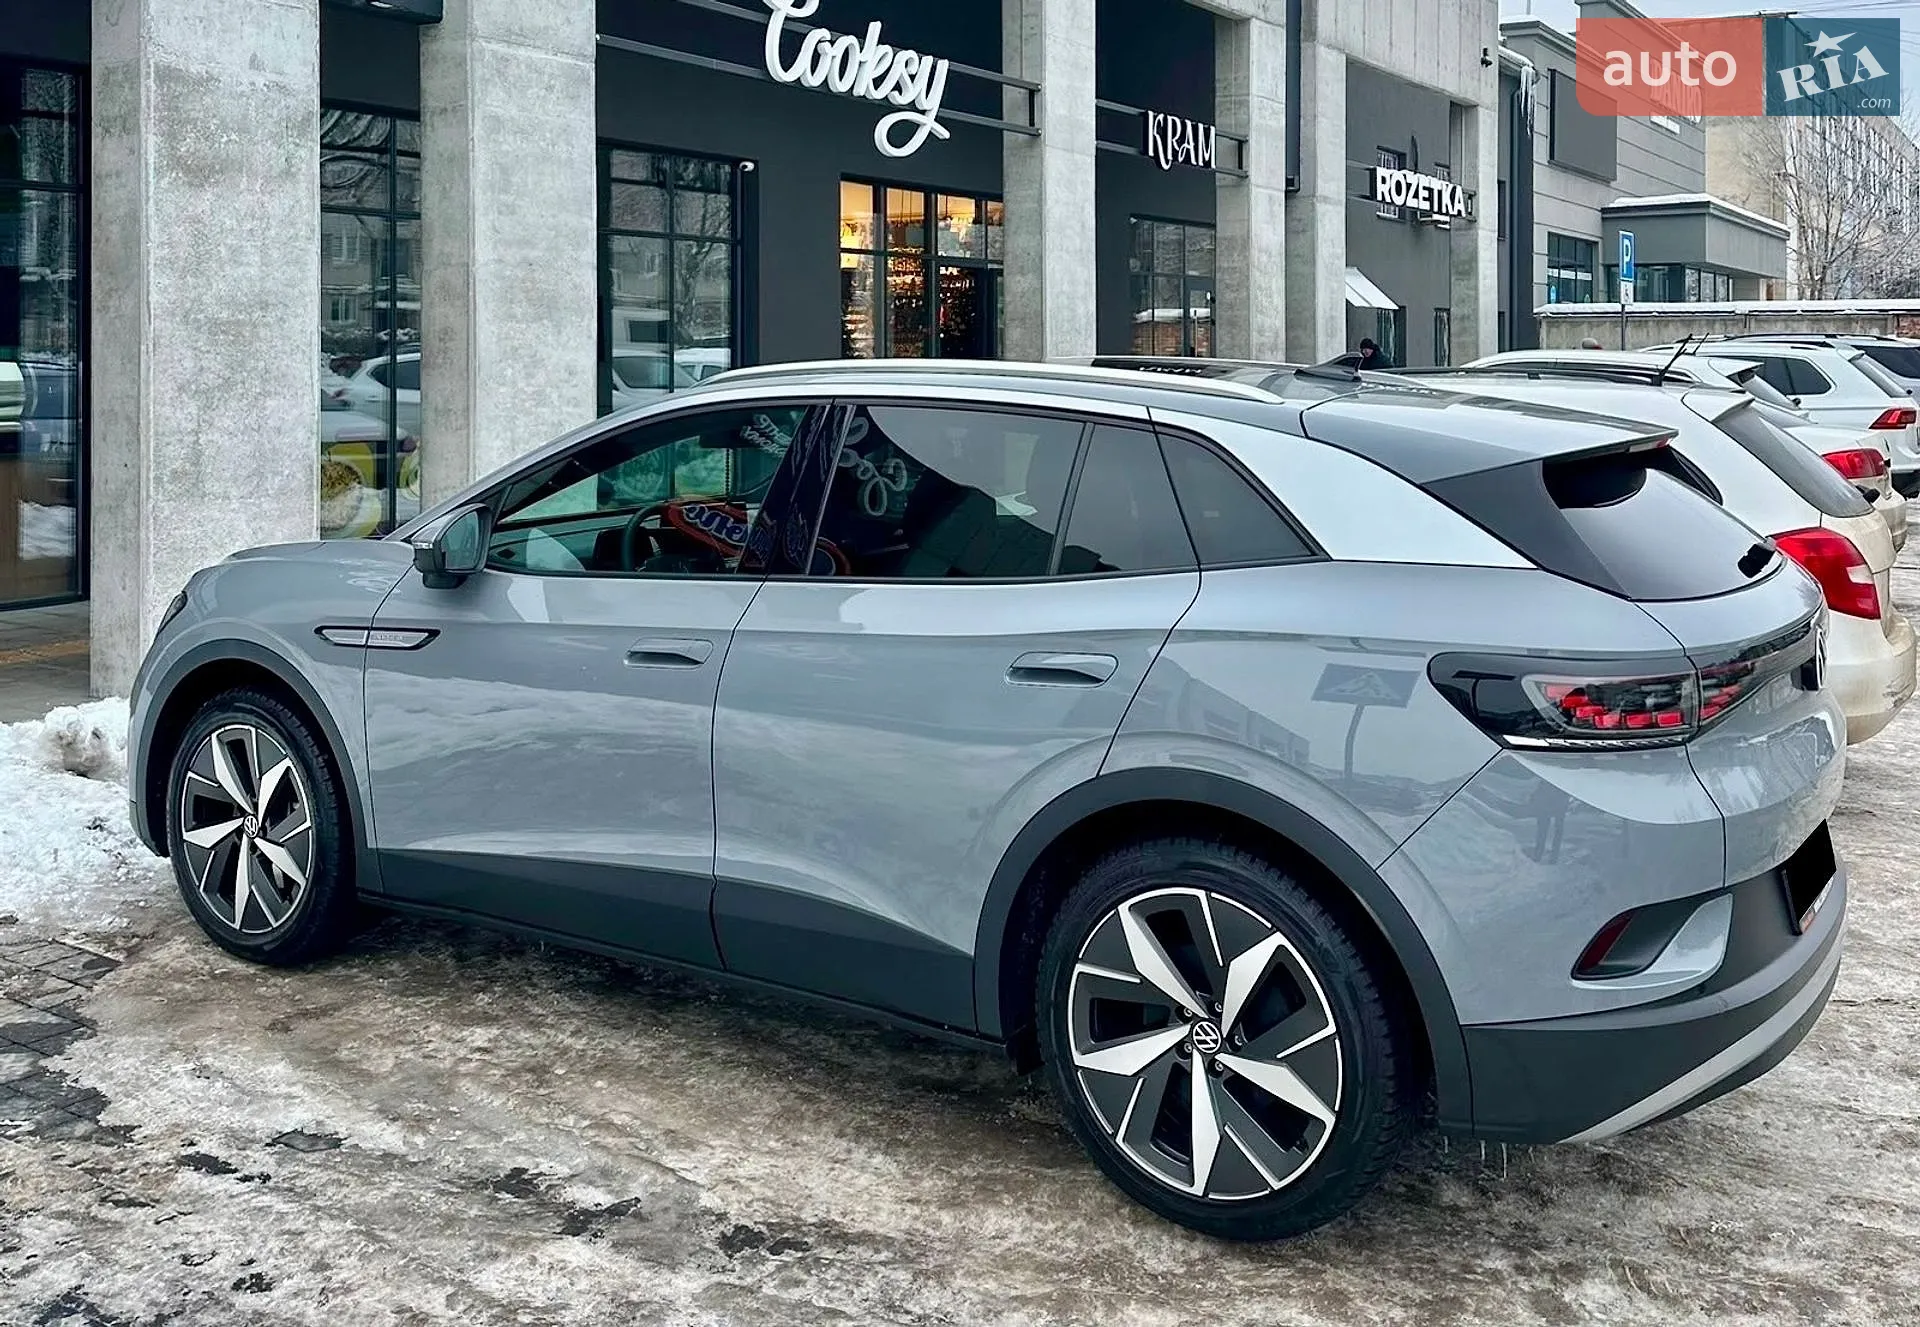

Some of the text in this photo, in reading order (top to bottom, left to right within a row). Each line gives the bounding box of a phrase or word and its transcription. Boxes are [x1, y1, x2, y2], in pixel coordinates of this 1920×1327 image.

[763, 0, 951, 157] Cooksy
[1147, 110, 1216, 170] KRAM
[1377, 166, 1466, 217] ROZETKA
[1623, 238, 1631, 274] P
